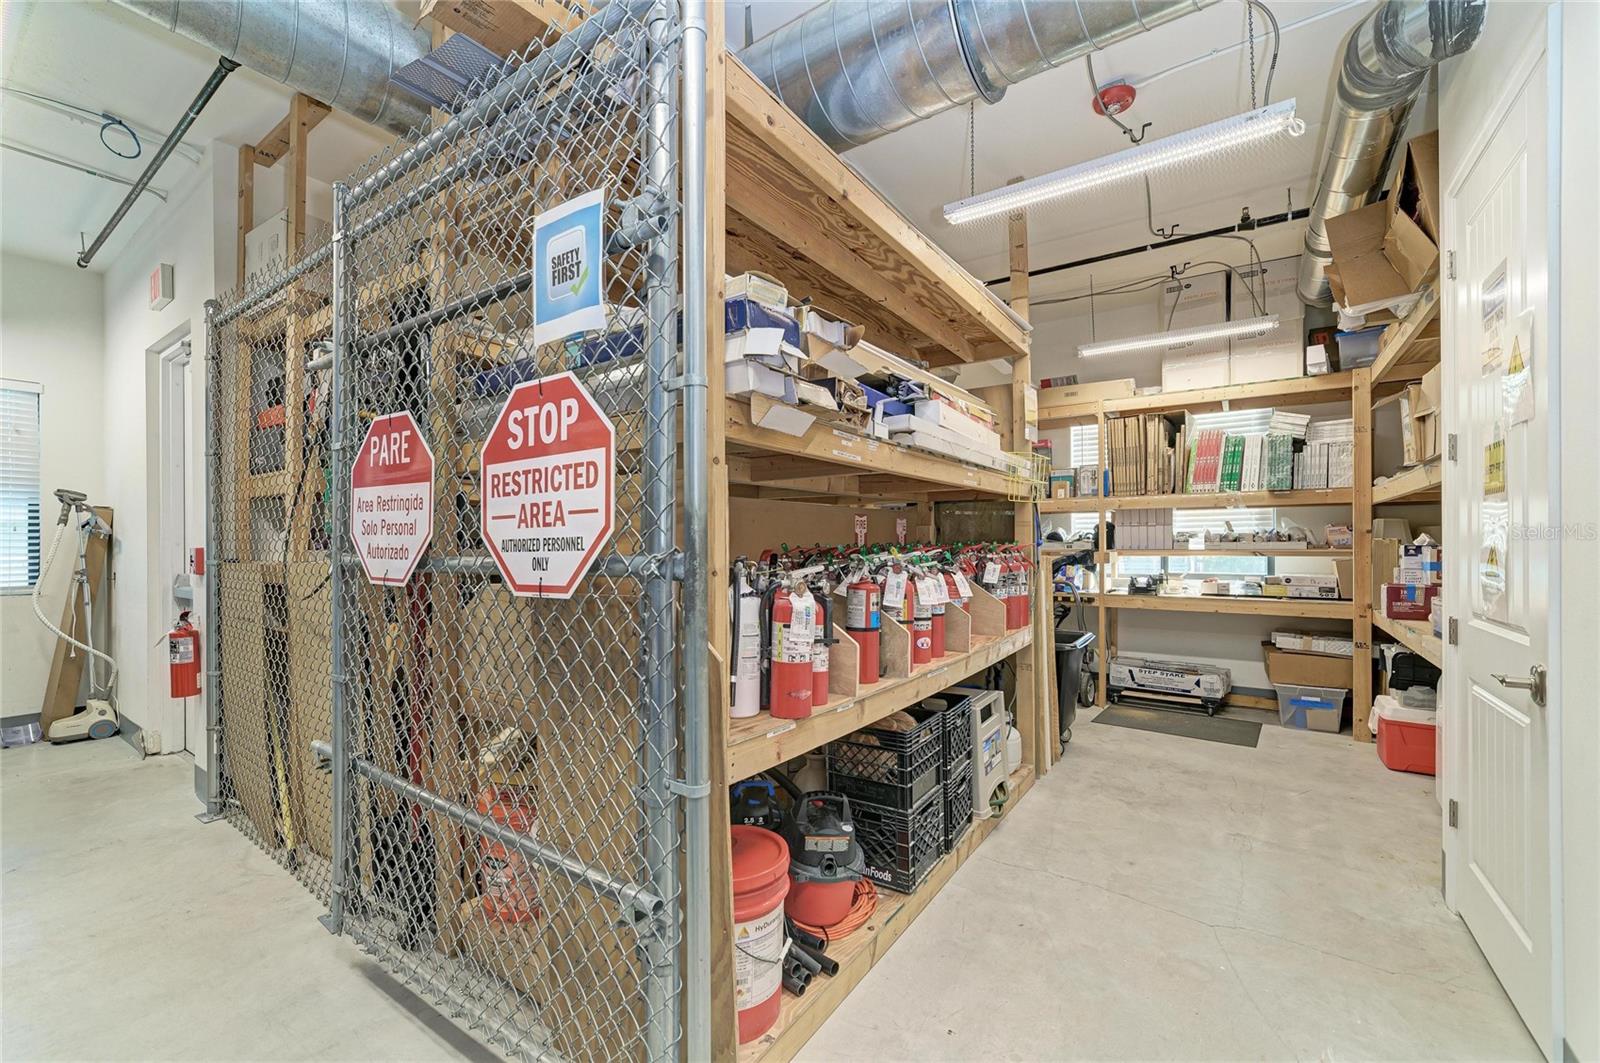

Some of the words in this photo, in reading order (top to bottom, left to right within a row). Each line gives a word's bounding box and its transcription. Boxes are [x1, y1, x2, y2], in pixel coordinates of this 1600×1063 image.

[551, 247, 580, 269] SAFETY
[552, 260, 582, 286] FIRST
[507, 398, 579, 450] STOP
[370, 430, 411, 467] PARE
[491, 460, 599, 498] RESTRICTED
[356, 497, 375, 513] Area
[376, 494, 423, 516] Restringida
[517, 500, 566, 529] AREA
[361, 519, 379, 536] Solo
[381, 518, 417, 536] Personal
[366, 544, 409, 561] Autorizado
[501, 540, 541, 553] AUTHORIZED
[542, 538, 585, 553] PERSONNEL
[532, 556, 549, 572] ONLY
[1160, 670, 1186, 678] STAKE
